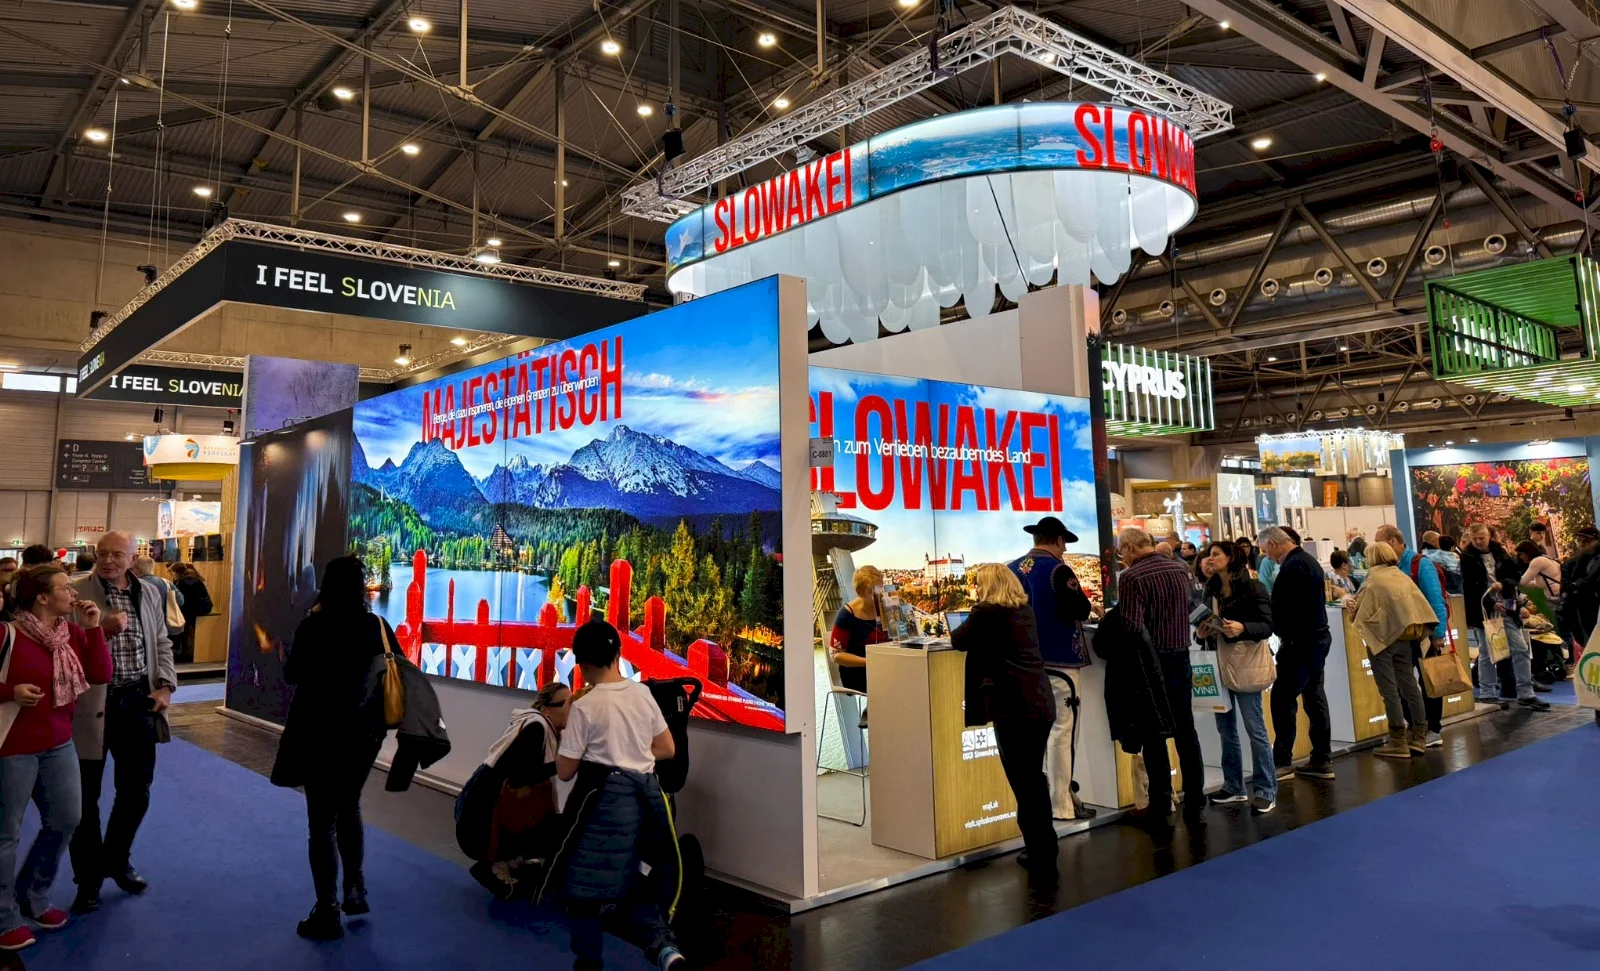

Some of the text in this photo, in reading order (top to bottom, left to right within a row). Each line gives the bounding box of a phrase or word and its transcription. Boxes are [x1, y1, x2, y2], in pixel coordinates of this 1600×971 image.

[714, 147, 853, 253] SLOWAKEI
[256, 264, 456, 310] I FEEL SLOVENIA
[109, 375, 119, 388] I
[122, 375, 163, 391] FEEL
[421, 335, 623, 450] MAJESTÄTISCH
[456, 407, 468, 419] dazu
[495, 397, 504, 410] die
[504, 393, 525, 409] eigenen
[526, 387, 551, 402] Grenzen
[551, 385, 560, 396] zu
[560, 374, 599, 394] überwinden
[72, 443, 80, 453] D
[809, 391, 1064, 512] LOWAKEI
[844, 440, 872, 455] zum
[874, 437, 928, 458] Verlieben
[930, 441, 1004, 462] bezauberndes
[1006, 446, 1031, 464] Land
[1194, 685, 1217, 695] VINA
